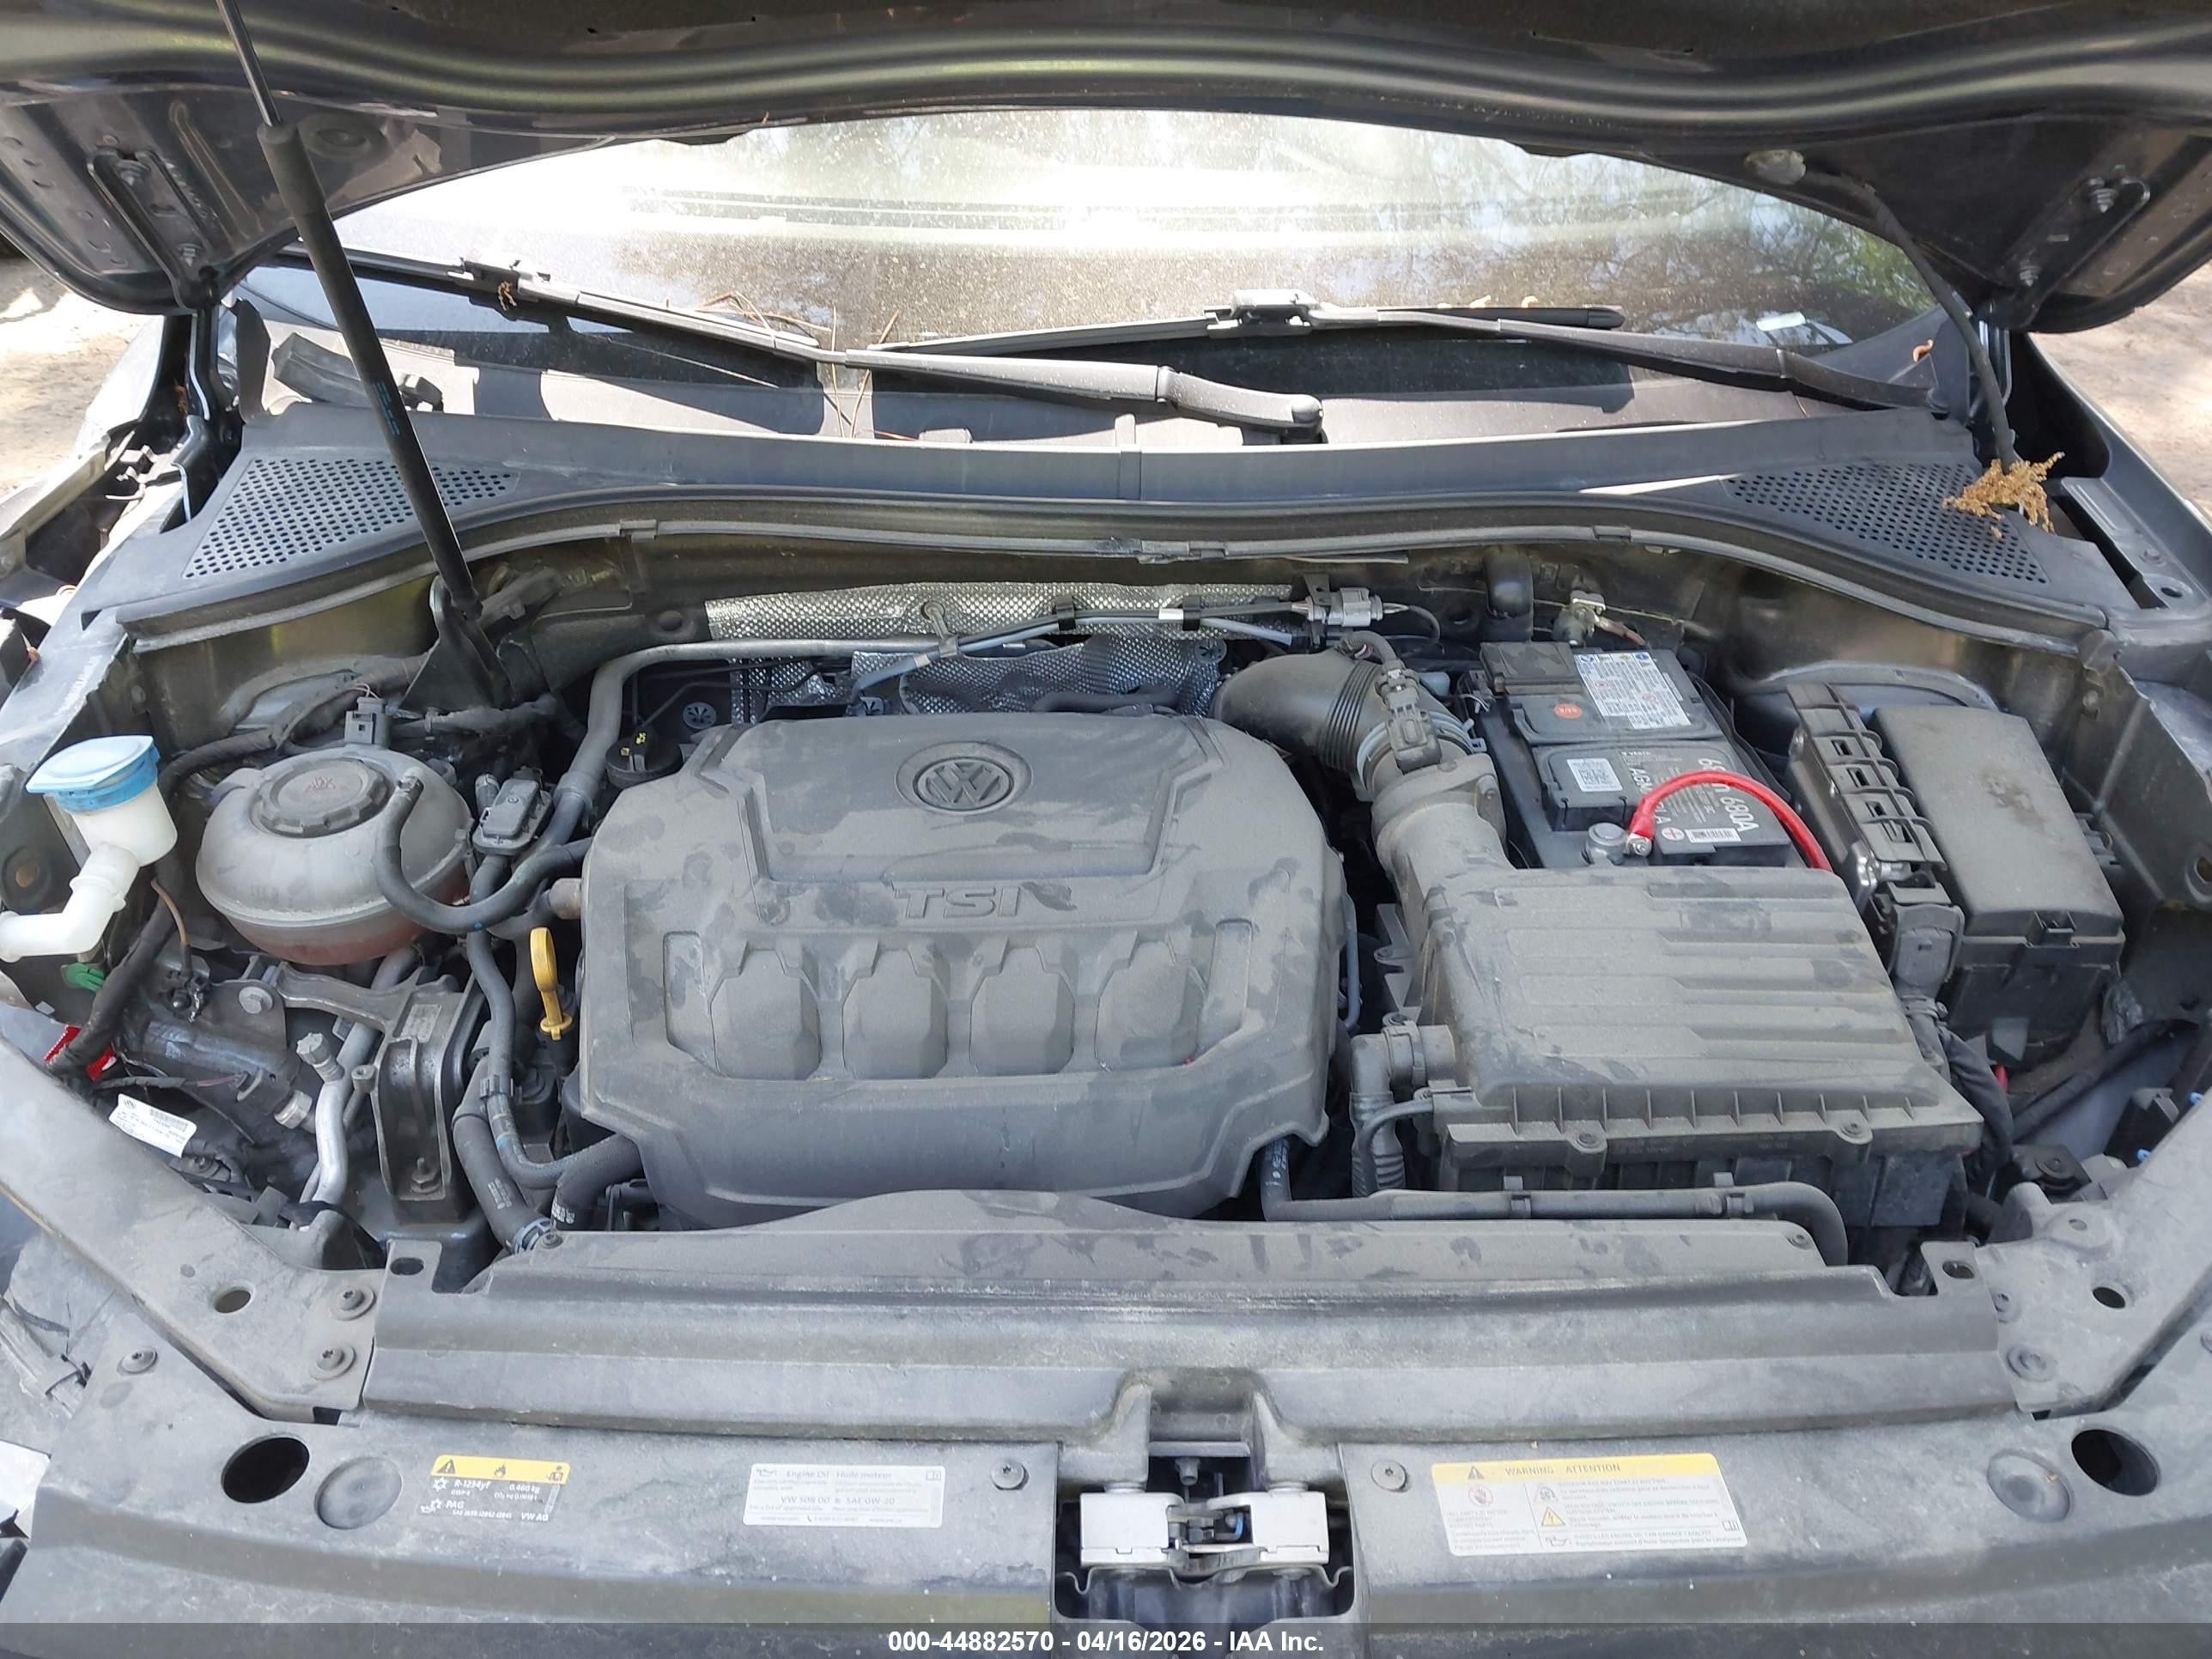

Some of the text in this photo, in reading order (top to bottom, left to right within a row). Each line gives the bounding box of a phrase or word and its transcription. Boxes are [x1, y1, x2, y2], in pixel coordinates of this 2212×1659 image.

[1719, 797, 1759, 832] 680A
[894, 885, 1022, 920] TSI
[787, 1469, 815, 1480] Engine
[1504, 1463, 1620, 1476] WARNING ATTENTION
[454, 1479, 492, 1492] R-1234yf
[509, 1483, 530, 1492] 0.460
[446, 1499, 465, 1509] PAG
[521, 1512, 549, 1522] VW AG
